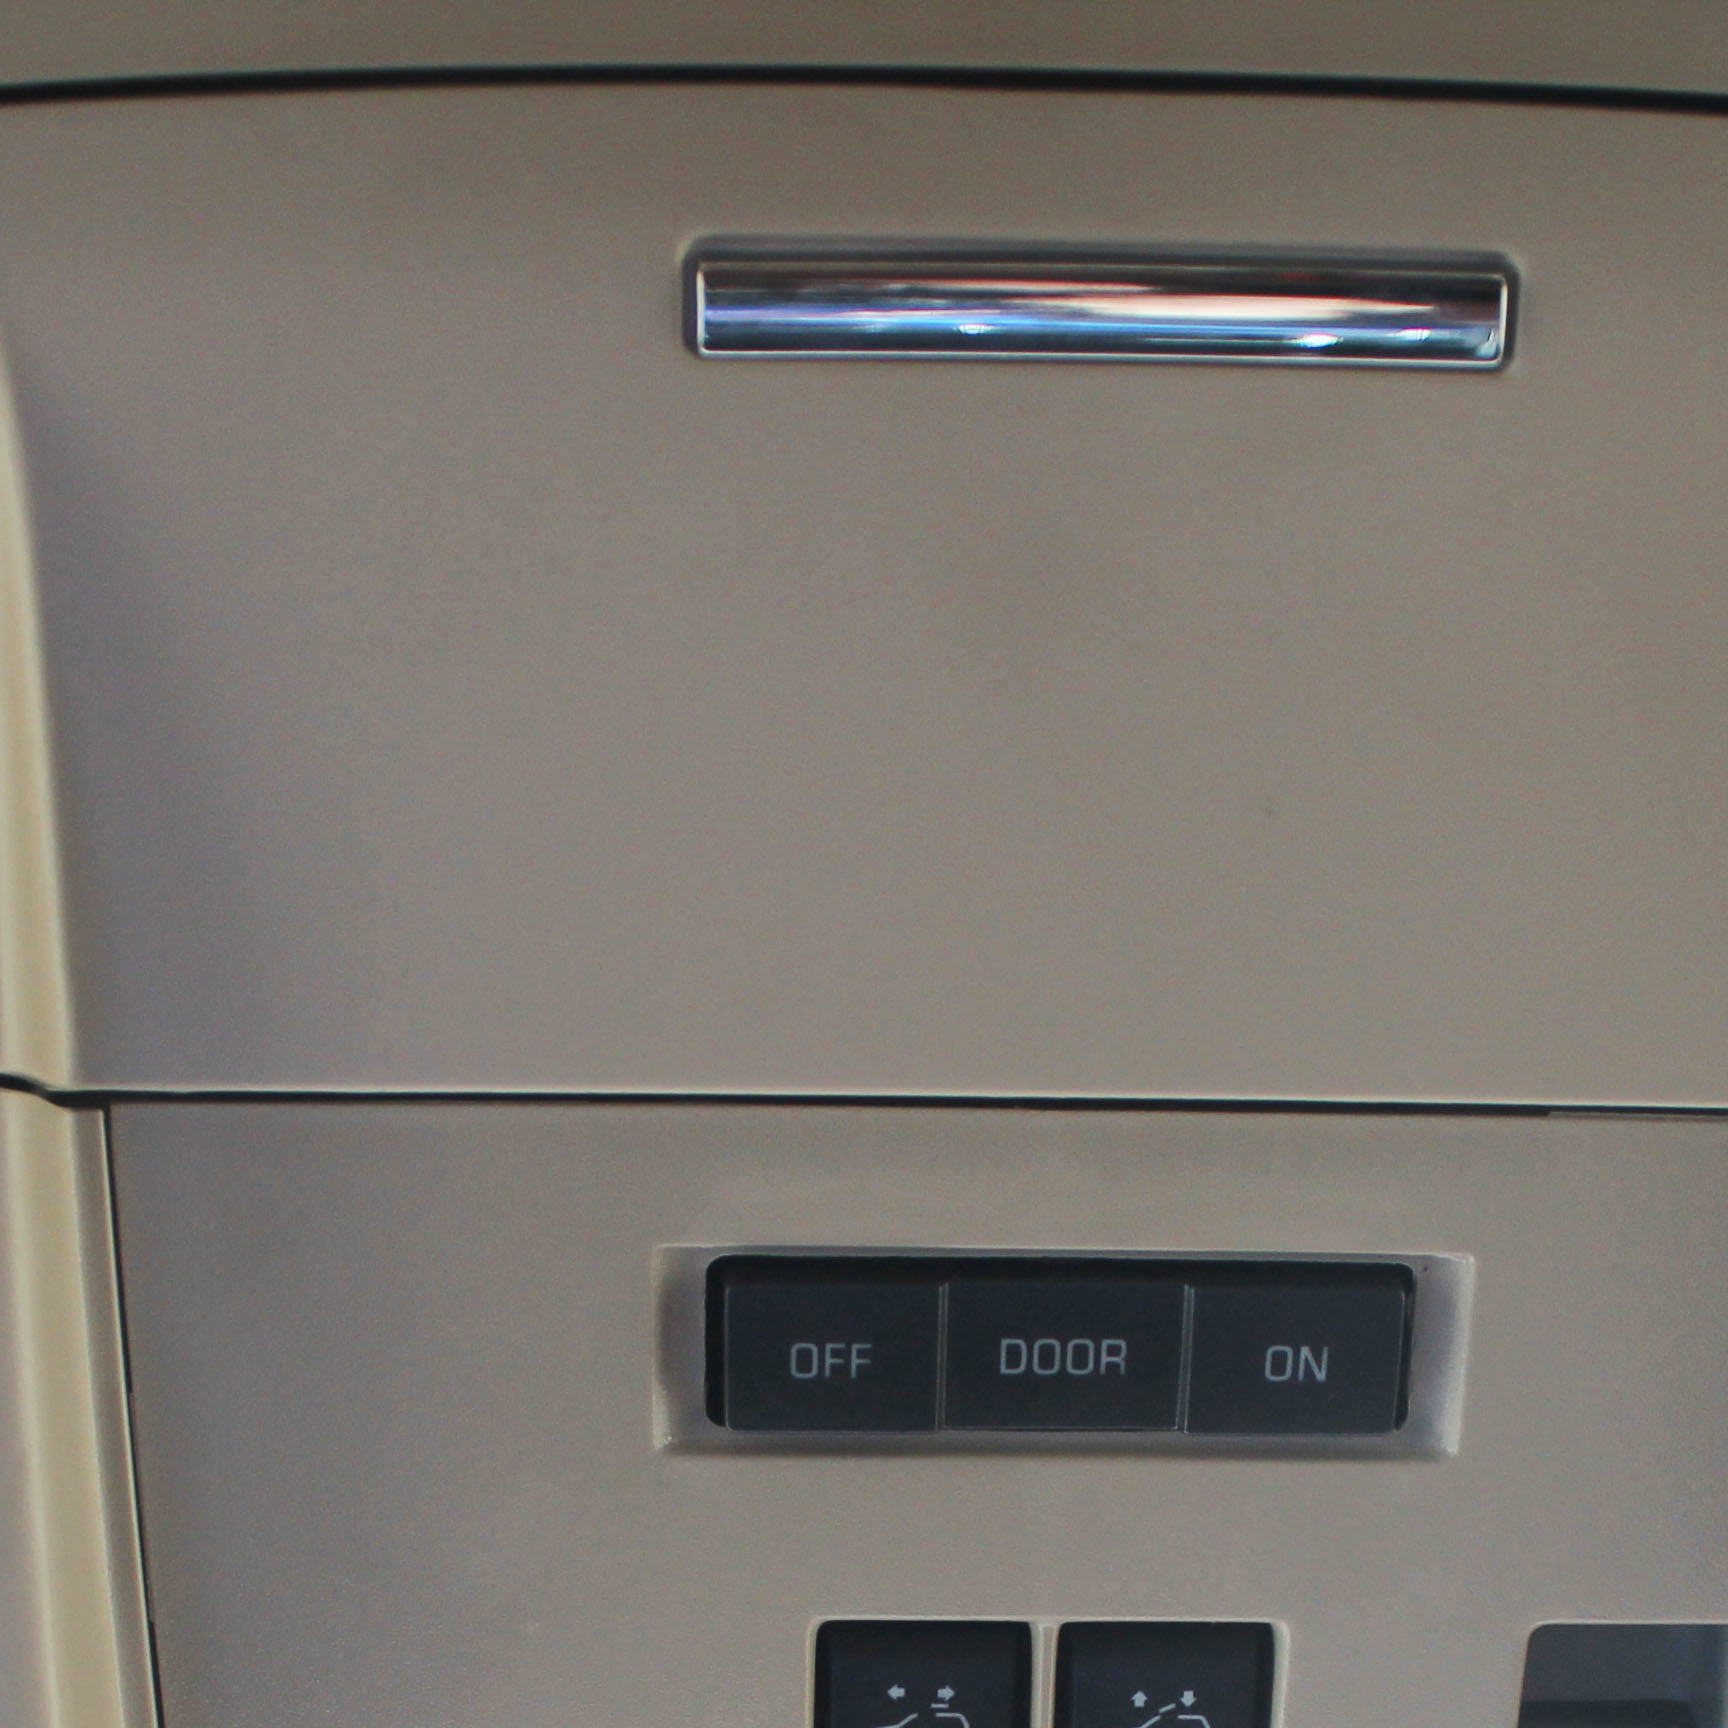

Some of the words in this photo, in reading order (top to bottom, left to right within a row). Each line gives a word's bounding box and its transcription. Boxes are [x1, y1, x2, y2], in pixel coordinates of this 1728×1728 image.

[788, 1342, 872, 1380] OFF
[999, 1338, 1129, 1377] DOOR
[1264, 1345, 1329, 1383] ON
